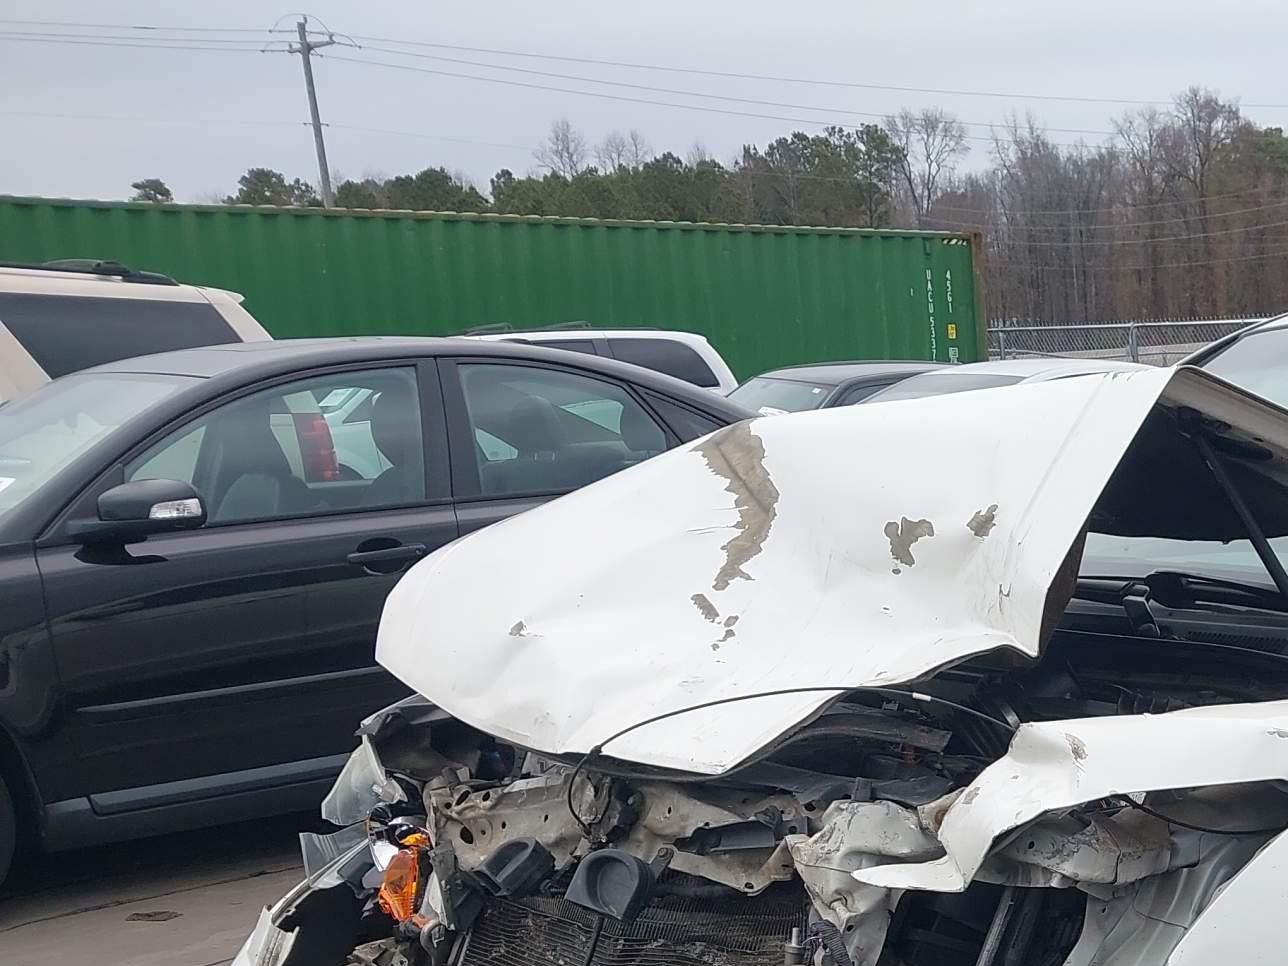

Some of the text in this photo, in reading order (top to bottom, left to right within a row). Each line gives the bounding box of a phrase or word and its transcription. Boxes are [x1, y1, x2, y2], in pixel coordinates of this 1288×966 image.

[926, 269, 937, 363] UACU 5337
[945, 269, 953, 313] 4561
